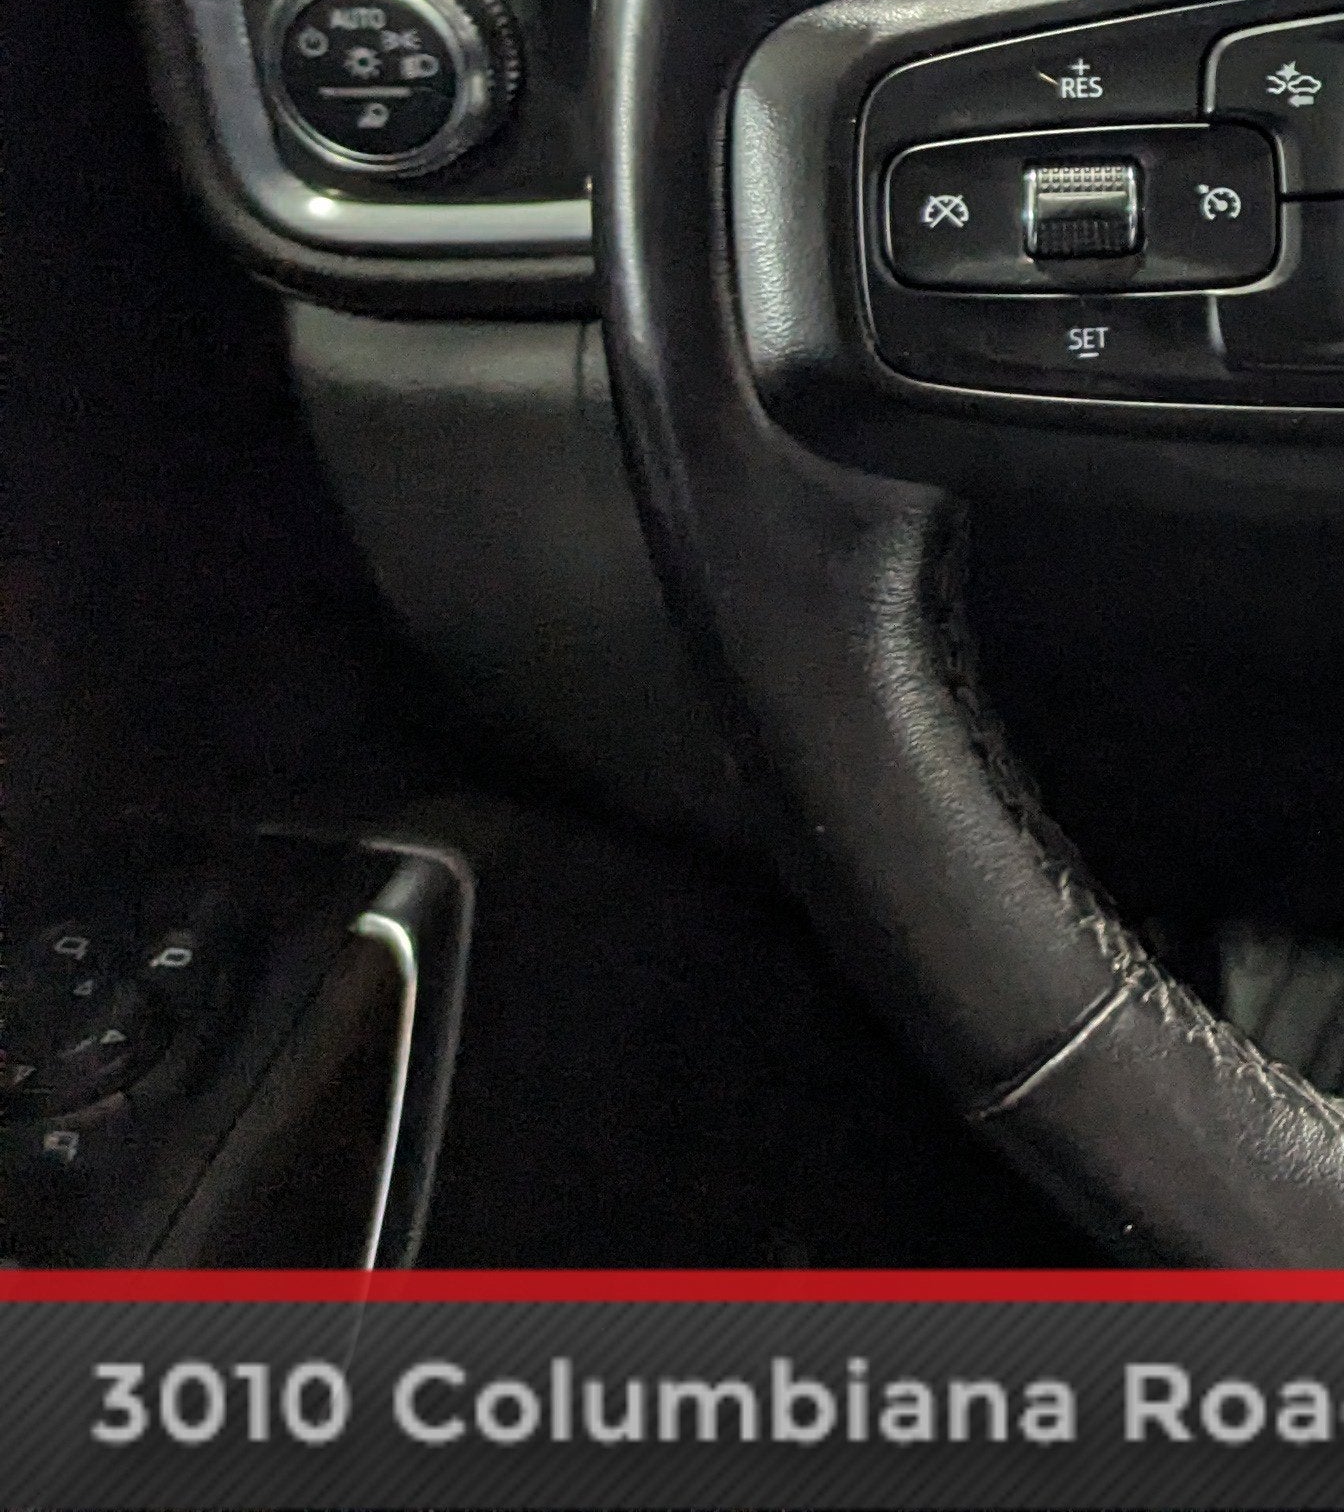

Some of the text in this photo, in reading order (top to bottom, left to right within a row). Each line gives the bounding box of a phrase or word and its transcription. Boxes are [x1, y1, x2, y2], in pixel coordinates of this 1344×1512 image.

[330, 7, 386, 30] AUTO
[1059, 76, 1103, 99] RES
[1068, 327, 1109, 350] SET
